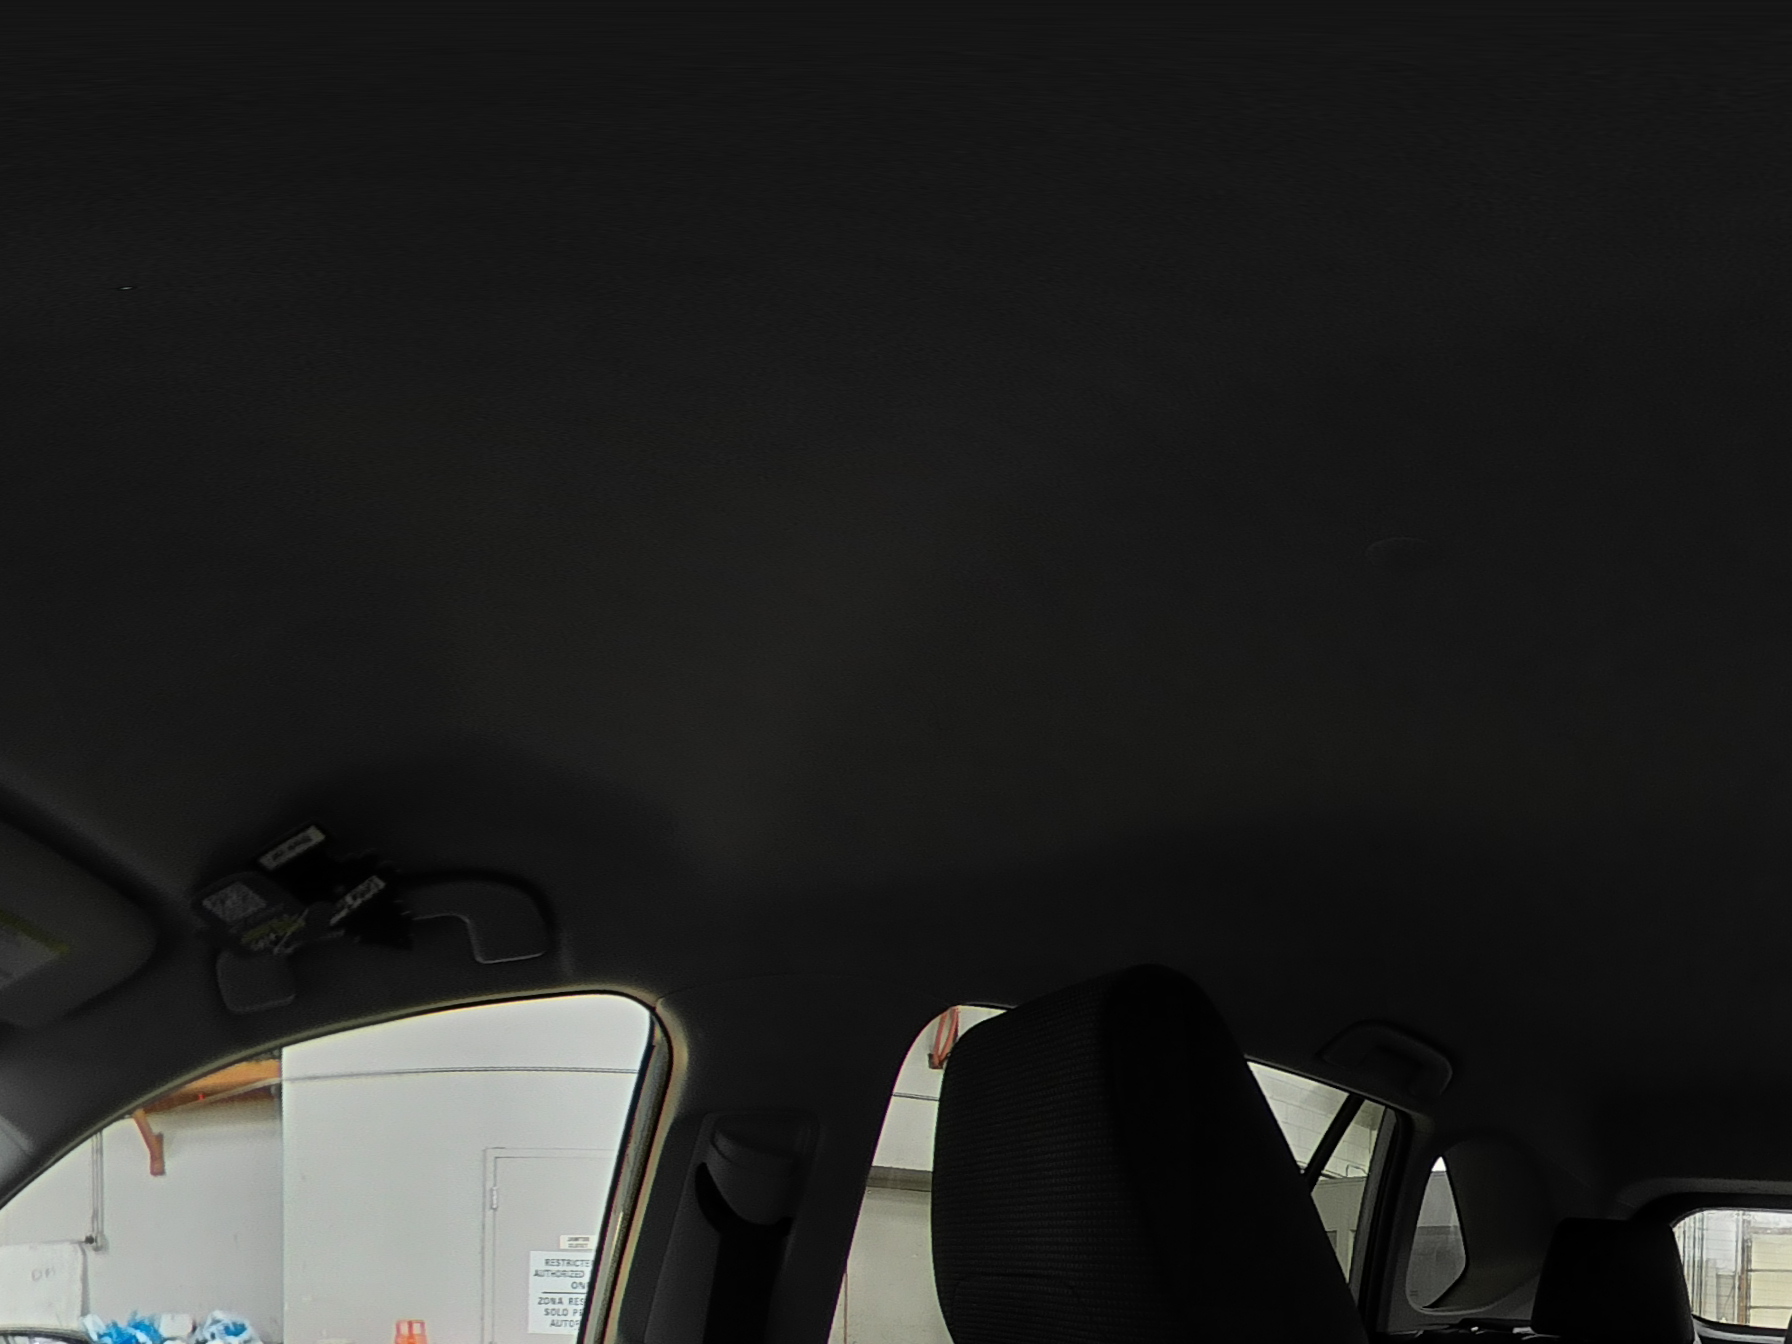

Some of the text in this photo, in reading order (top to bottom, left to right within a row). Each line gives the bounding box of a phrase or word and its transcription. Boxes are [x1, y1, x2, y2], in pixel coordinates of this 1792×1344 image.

[545, 1258, 592, 1267] RESTRICTE
[533, 1269, 585, 1278] AUTHORIZED
[537, 1297, 564, 1305] ZONA
[544, 1308, 569, 1317] SOLO
